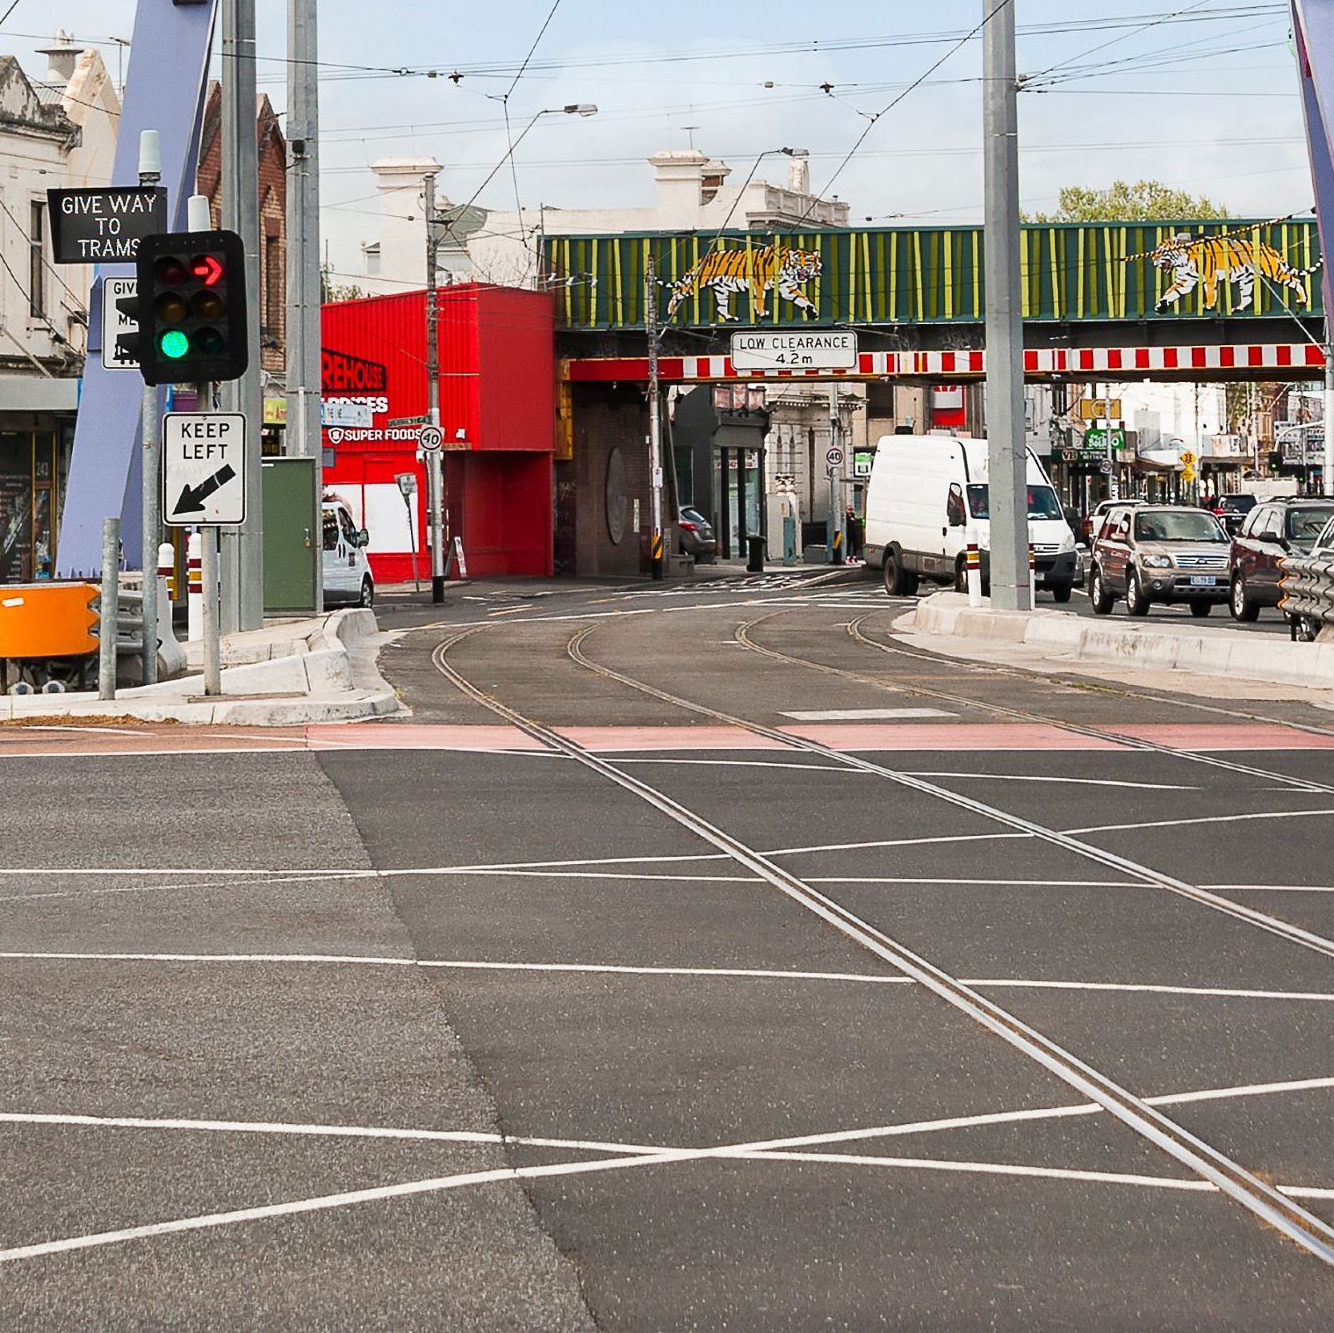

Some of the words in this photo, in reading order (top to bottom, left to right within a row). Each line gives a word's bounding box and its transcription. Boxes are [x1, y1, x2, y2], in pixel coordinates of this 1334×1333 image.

[61, 195, 103, 215] GIVE
[108, 194, 157, 214] WAY
[94, 217, 121, 236] TO
[77, 238, 141, 258] TRAMS
[113, 282, 138, 295] GIV
[739, 337, 766, 350] LOW
[771, 336, 849, 349] CLEARANCE
[323, 354, 384, 389] REHOUSE
[181, 422, 230, 438] KEEP
[344, 429, 383, 441] SUPER
[384, 428, 422, 441] FOODS
[423, 433, 440, 445] 40
[183, 444, 228, 459] LEFT
[829, 451, 841, 462] 40
